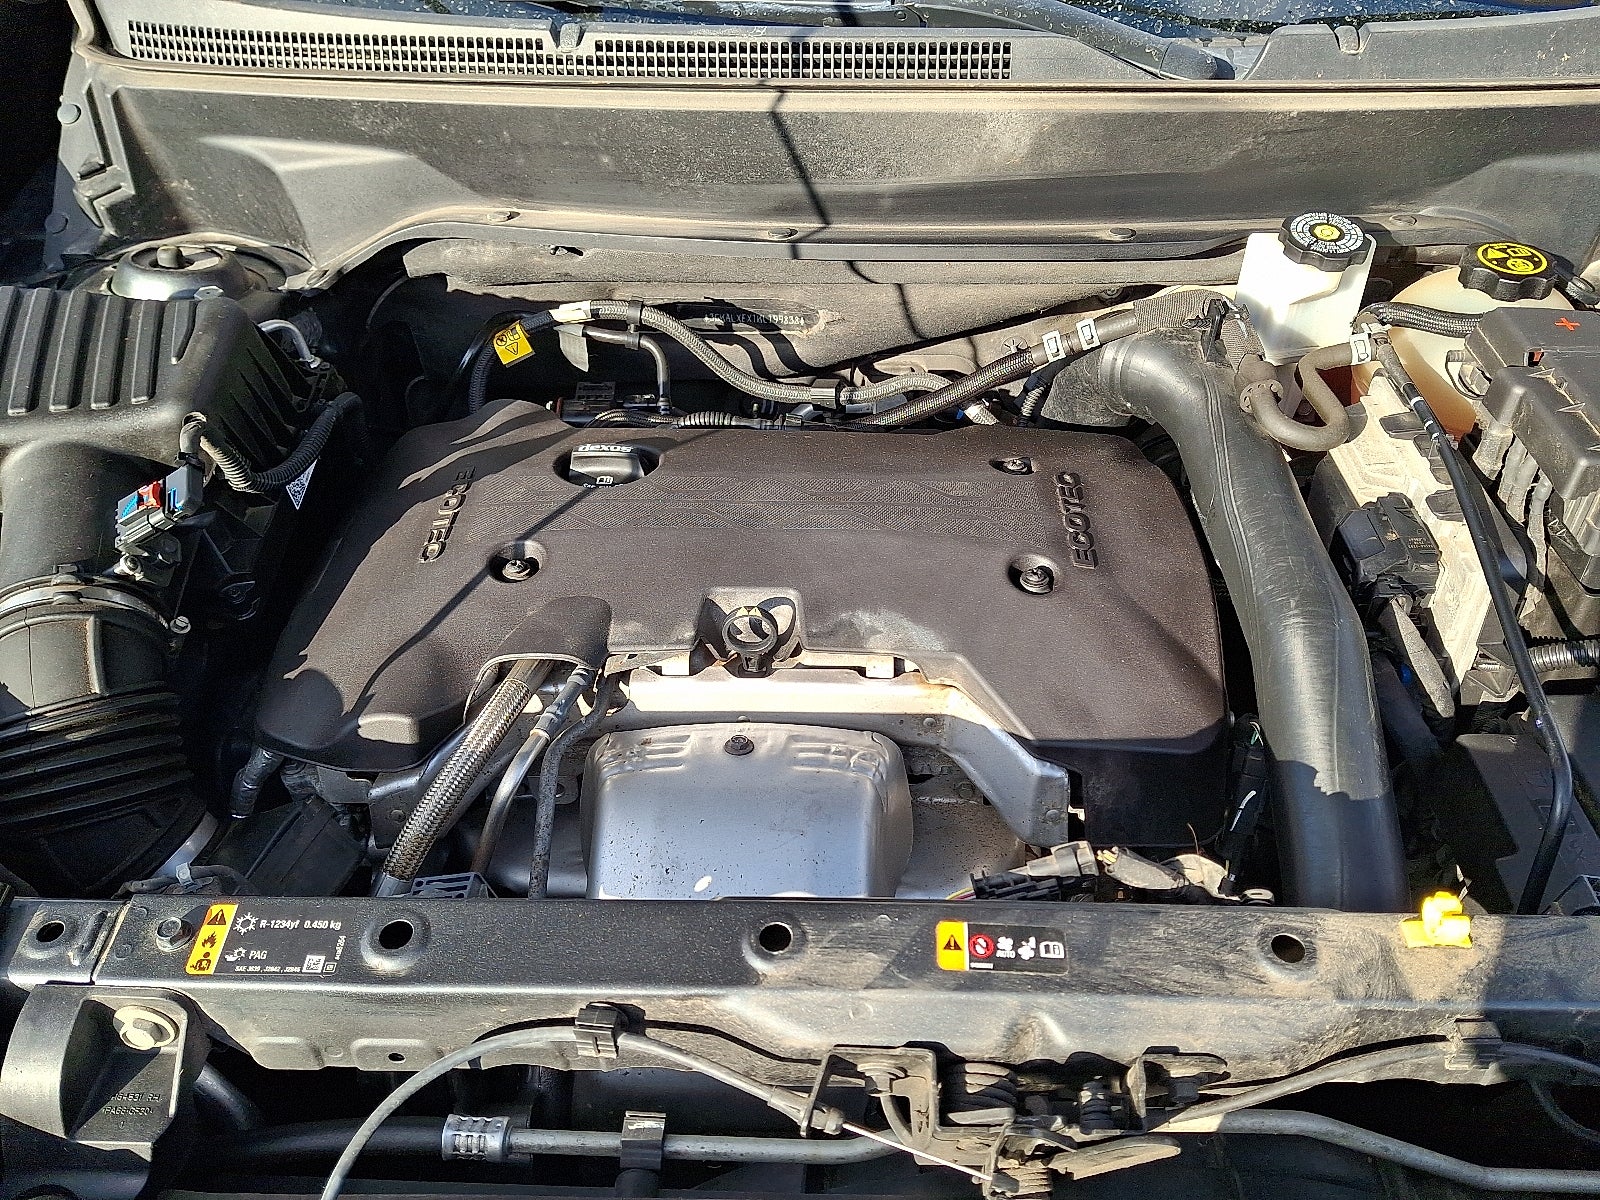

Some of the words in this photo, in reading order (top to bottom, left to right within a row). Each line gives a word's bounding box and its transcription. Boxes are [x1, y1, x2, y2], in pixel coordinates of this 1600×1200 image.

[578, 444, 633, 453] dexos
[420, 466, 477, 563] ECOTEC
[1054, 472, 1099, 569] ECOTEC
[259, 920, 300, 930] R-1234yf
[304, 920, 328, 929] 0.450
[330, 920, 342, 931] kg
[249, 950, 267, 960] PAG
[996, 950, 1016, 958] AUTO
